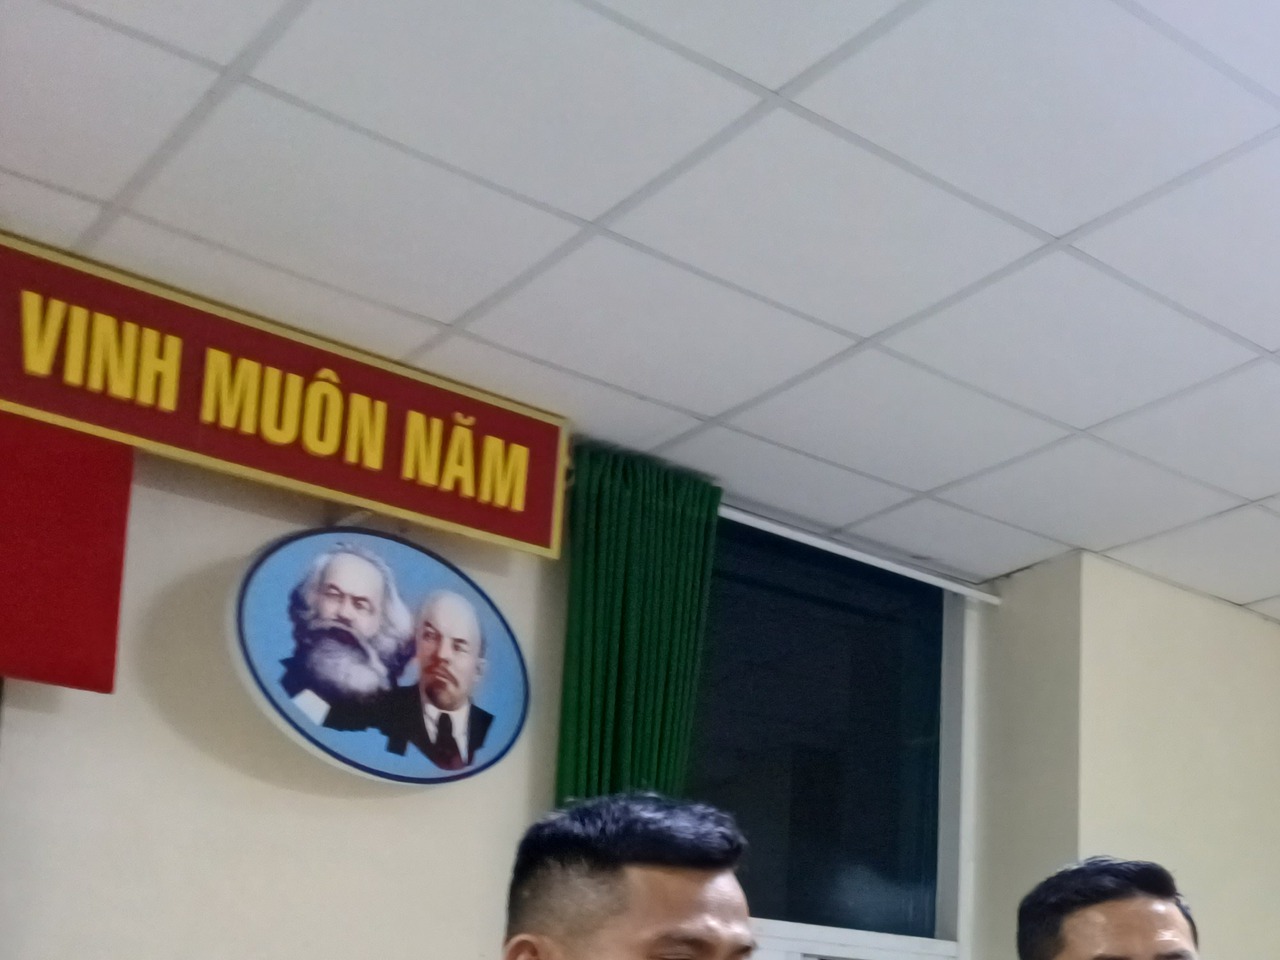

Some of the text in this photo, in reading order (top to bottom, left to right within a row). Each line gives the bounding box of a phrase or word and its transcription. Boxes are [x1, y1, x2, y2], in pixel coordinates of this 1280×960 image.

[21, 291, 529, 512] VINH MUÔN NĂM
